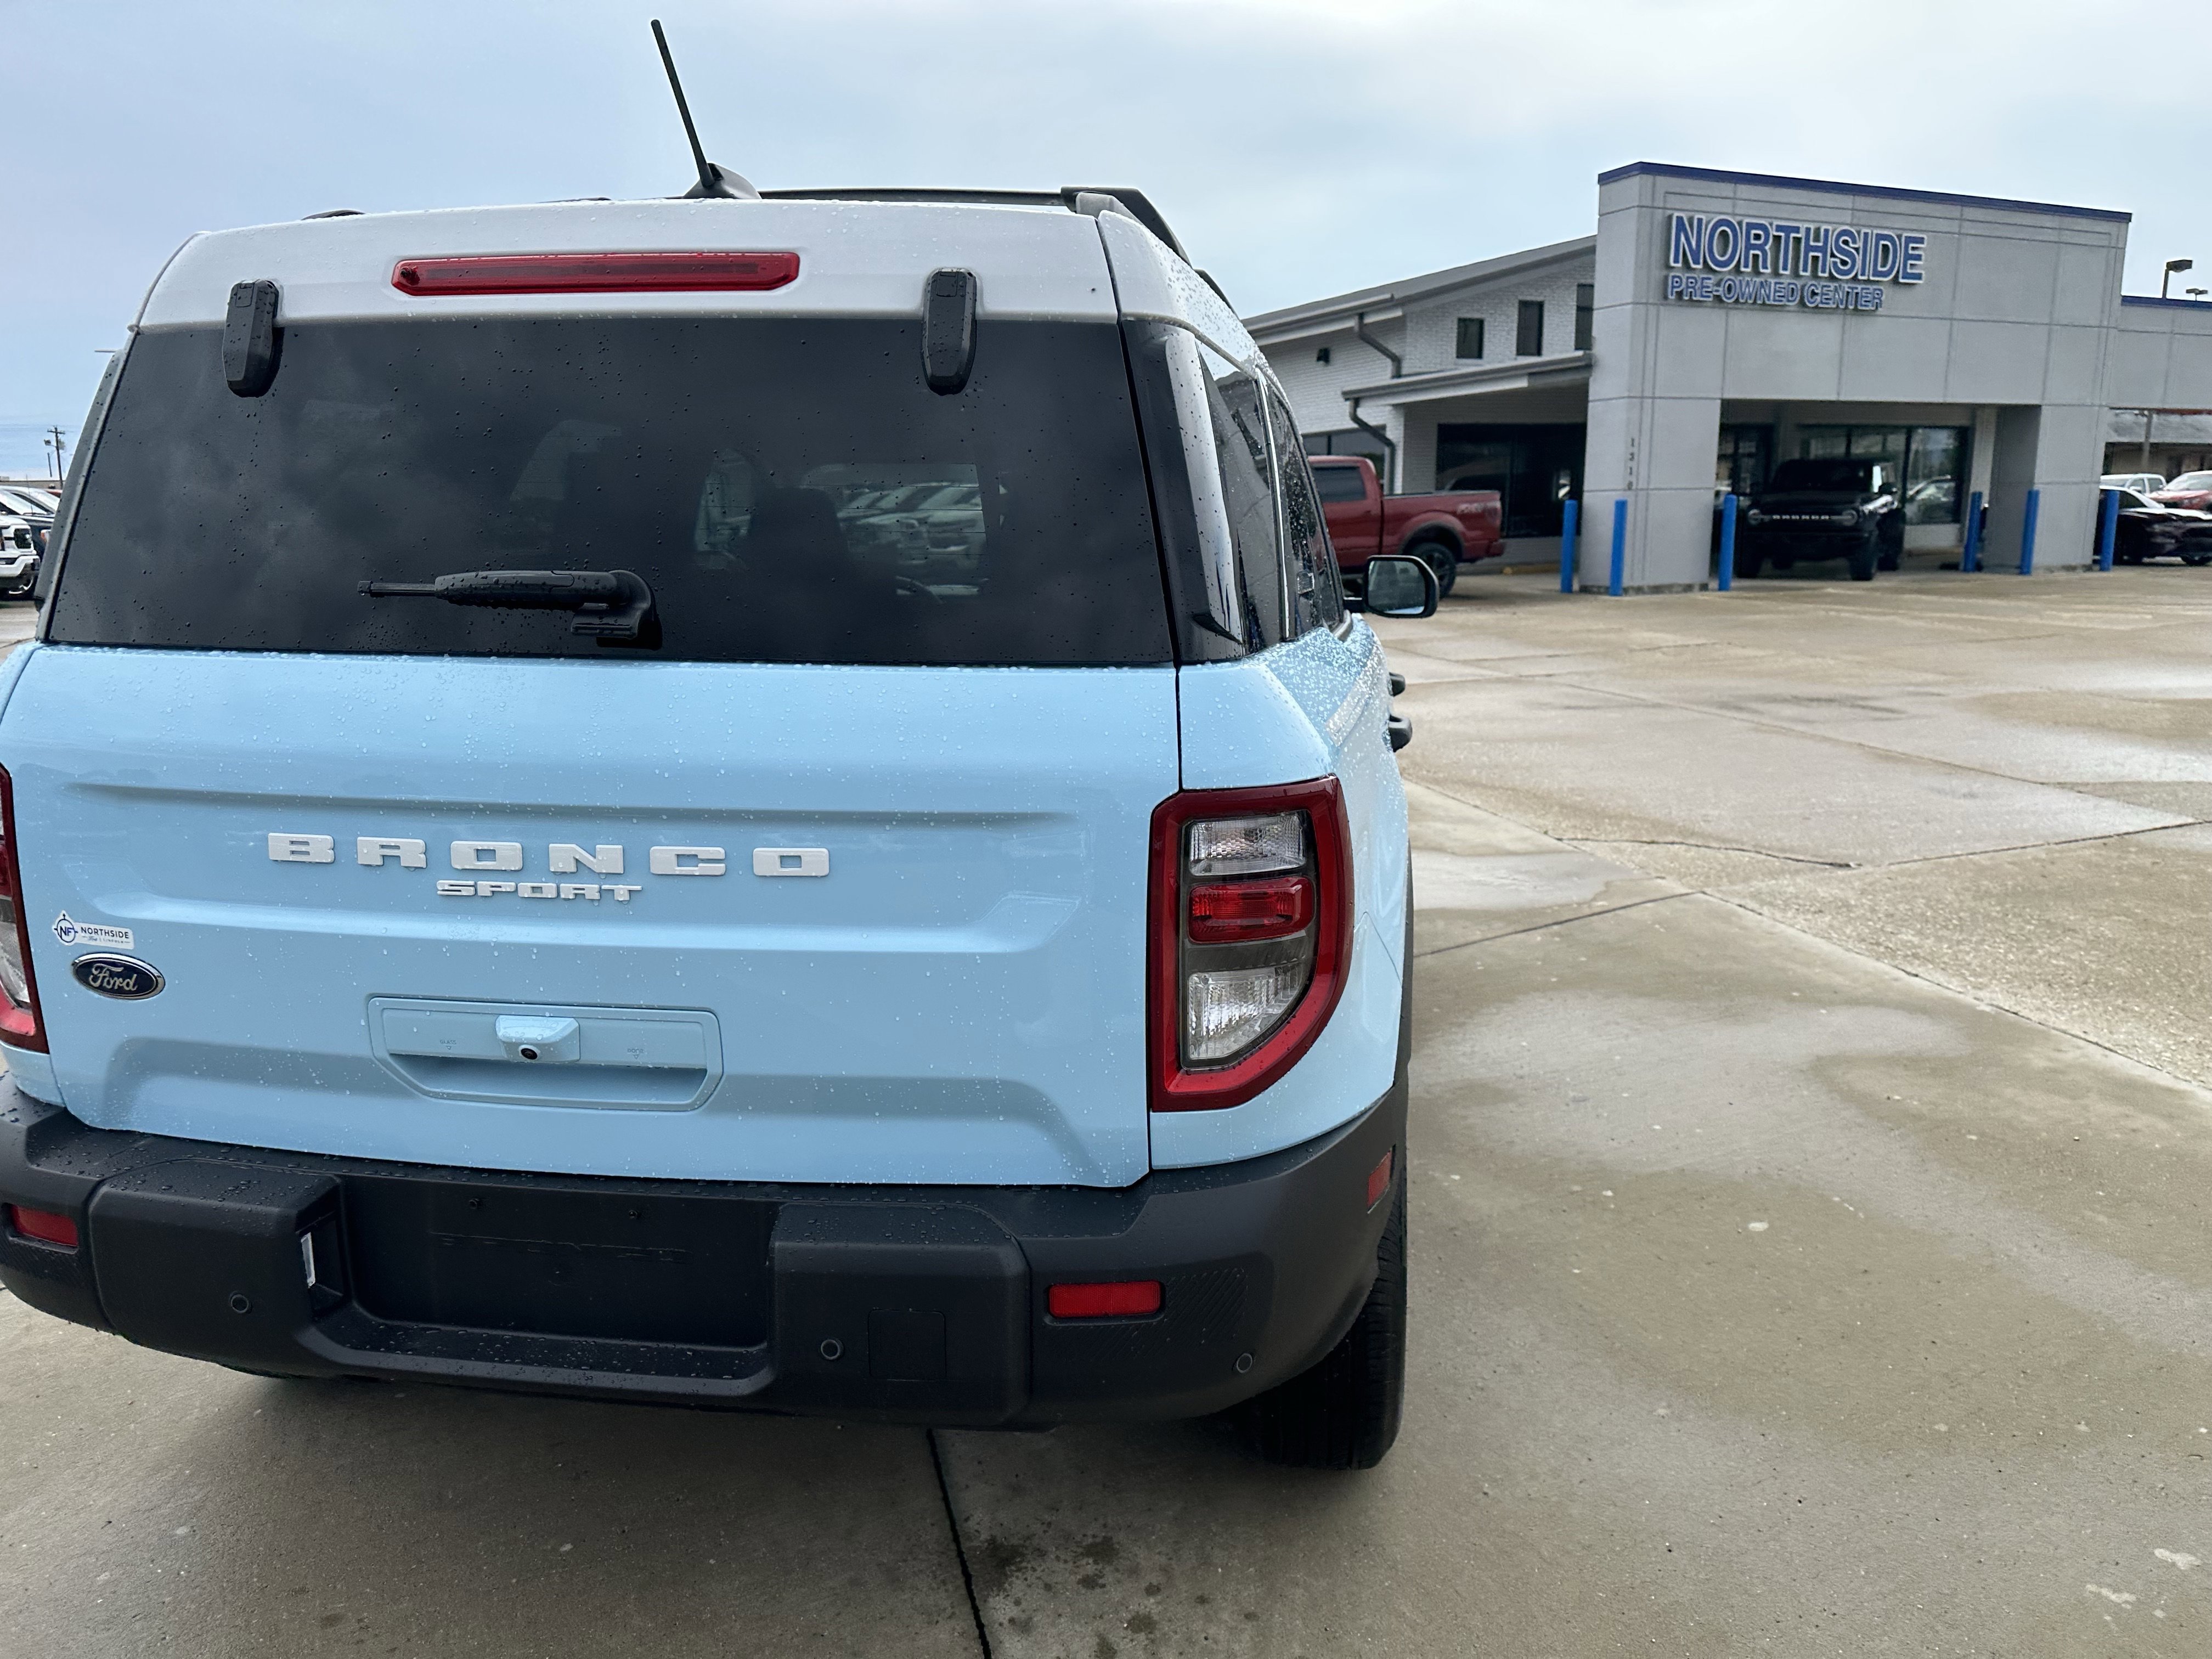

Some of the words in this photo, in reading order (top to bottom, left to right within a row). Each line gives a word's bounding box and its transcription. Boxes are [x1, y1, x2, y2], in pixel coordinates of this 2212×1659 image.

[1669, 213, 1926, 284] NORTHSIDE
[1668, 274, 1799, 306] PRE-OWNED
[1804, 281, 1884, 311] CENTER
[268, 832, 830, 877] BRONCO
[436, 880, 642, 901] SPORT
[60, 926, 74, 936] NF
[81, 927, 129, 939] NORTHSIDE
[89, 963, 137, 991] Ford
